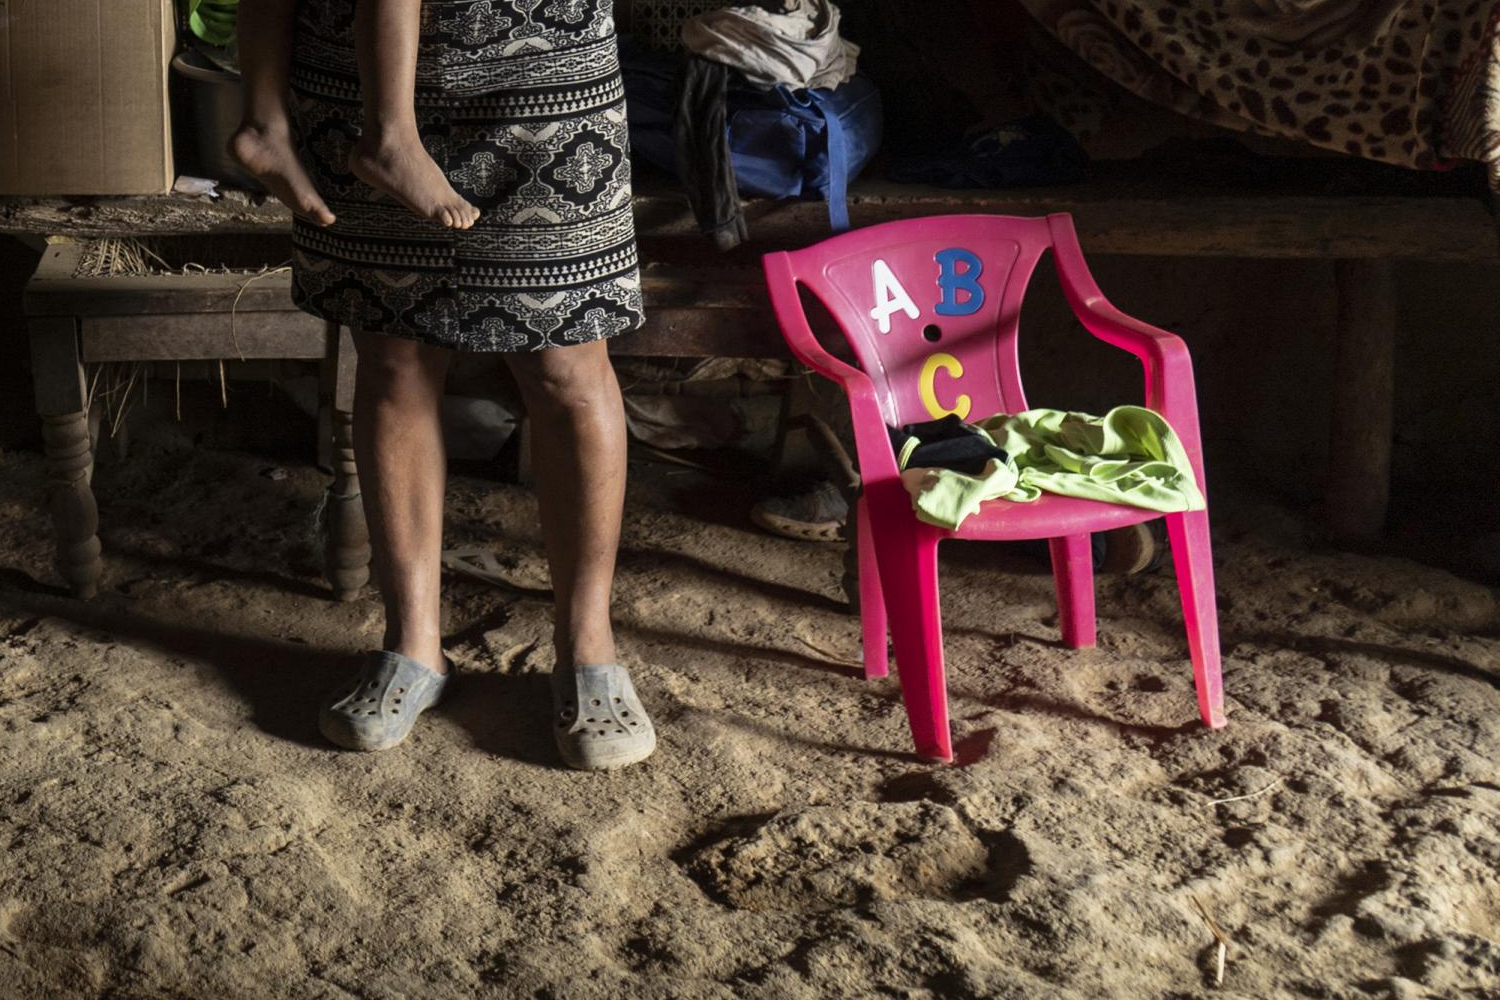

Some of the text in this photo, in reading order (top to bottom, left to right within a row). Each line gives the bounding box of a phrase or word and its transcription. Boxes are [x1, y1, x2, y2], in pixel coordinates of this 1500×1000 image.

[870, 248, 985, 334] A B
[919, 353, 971, 421] C
